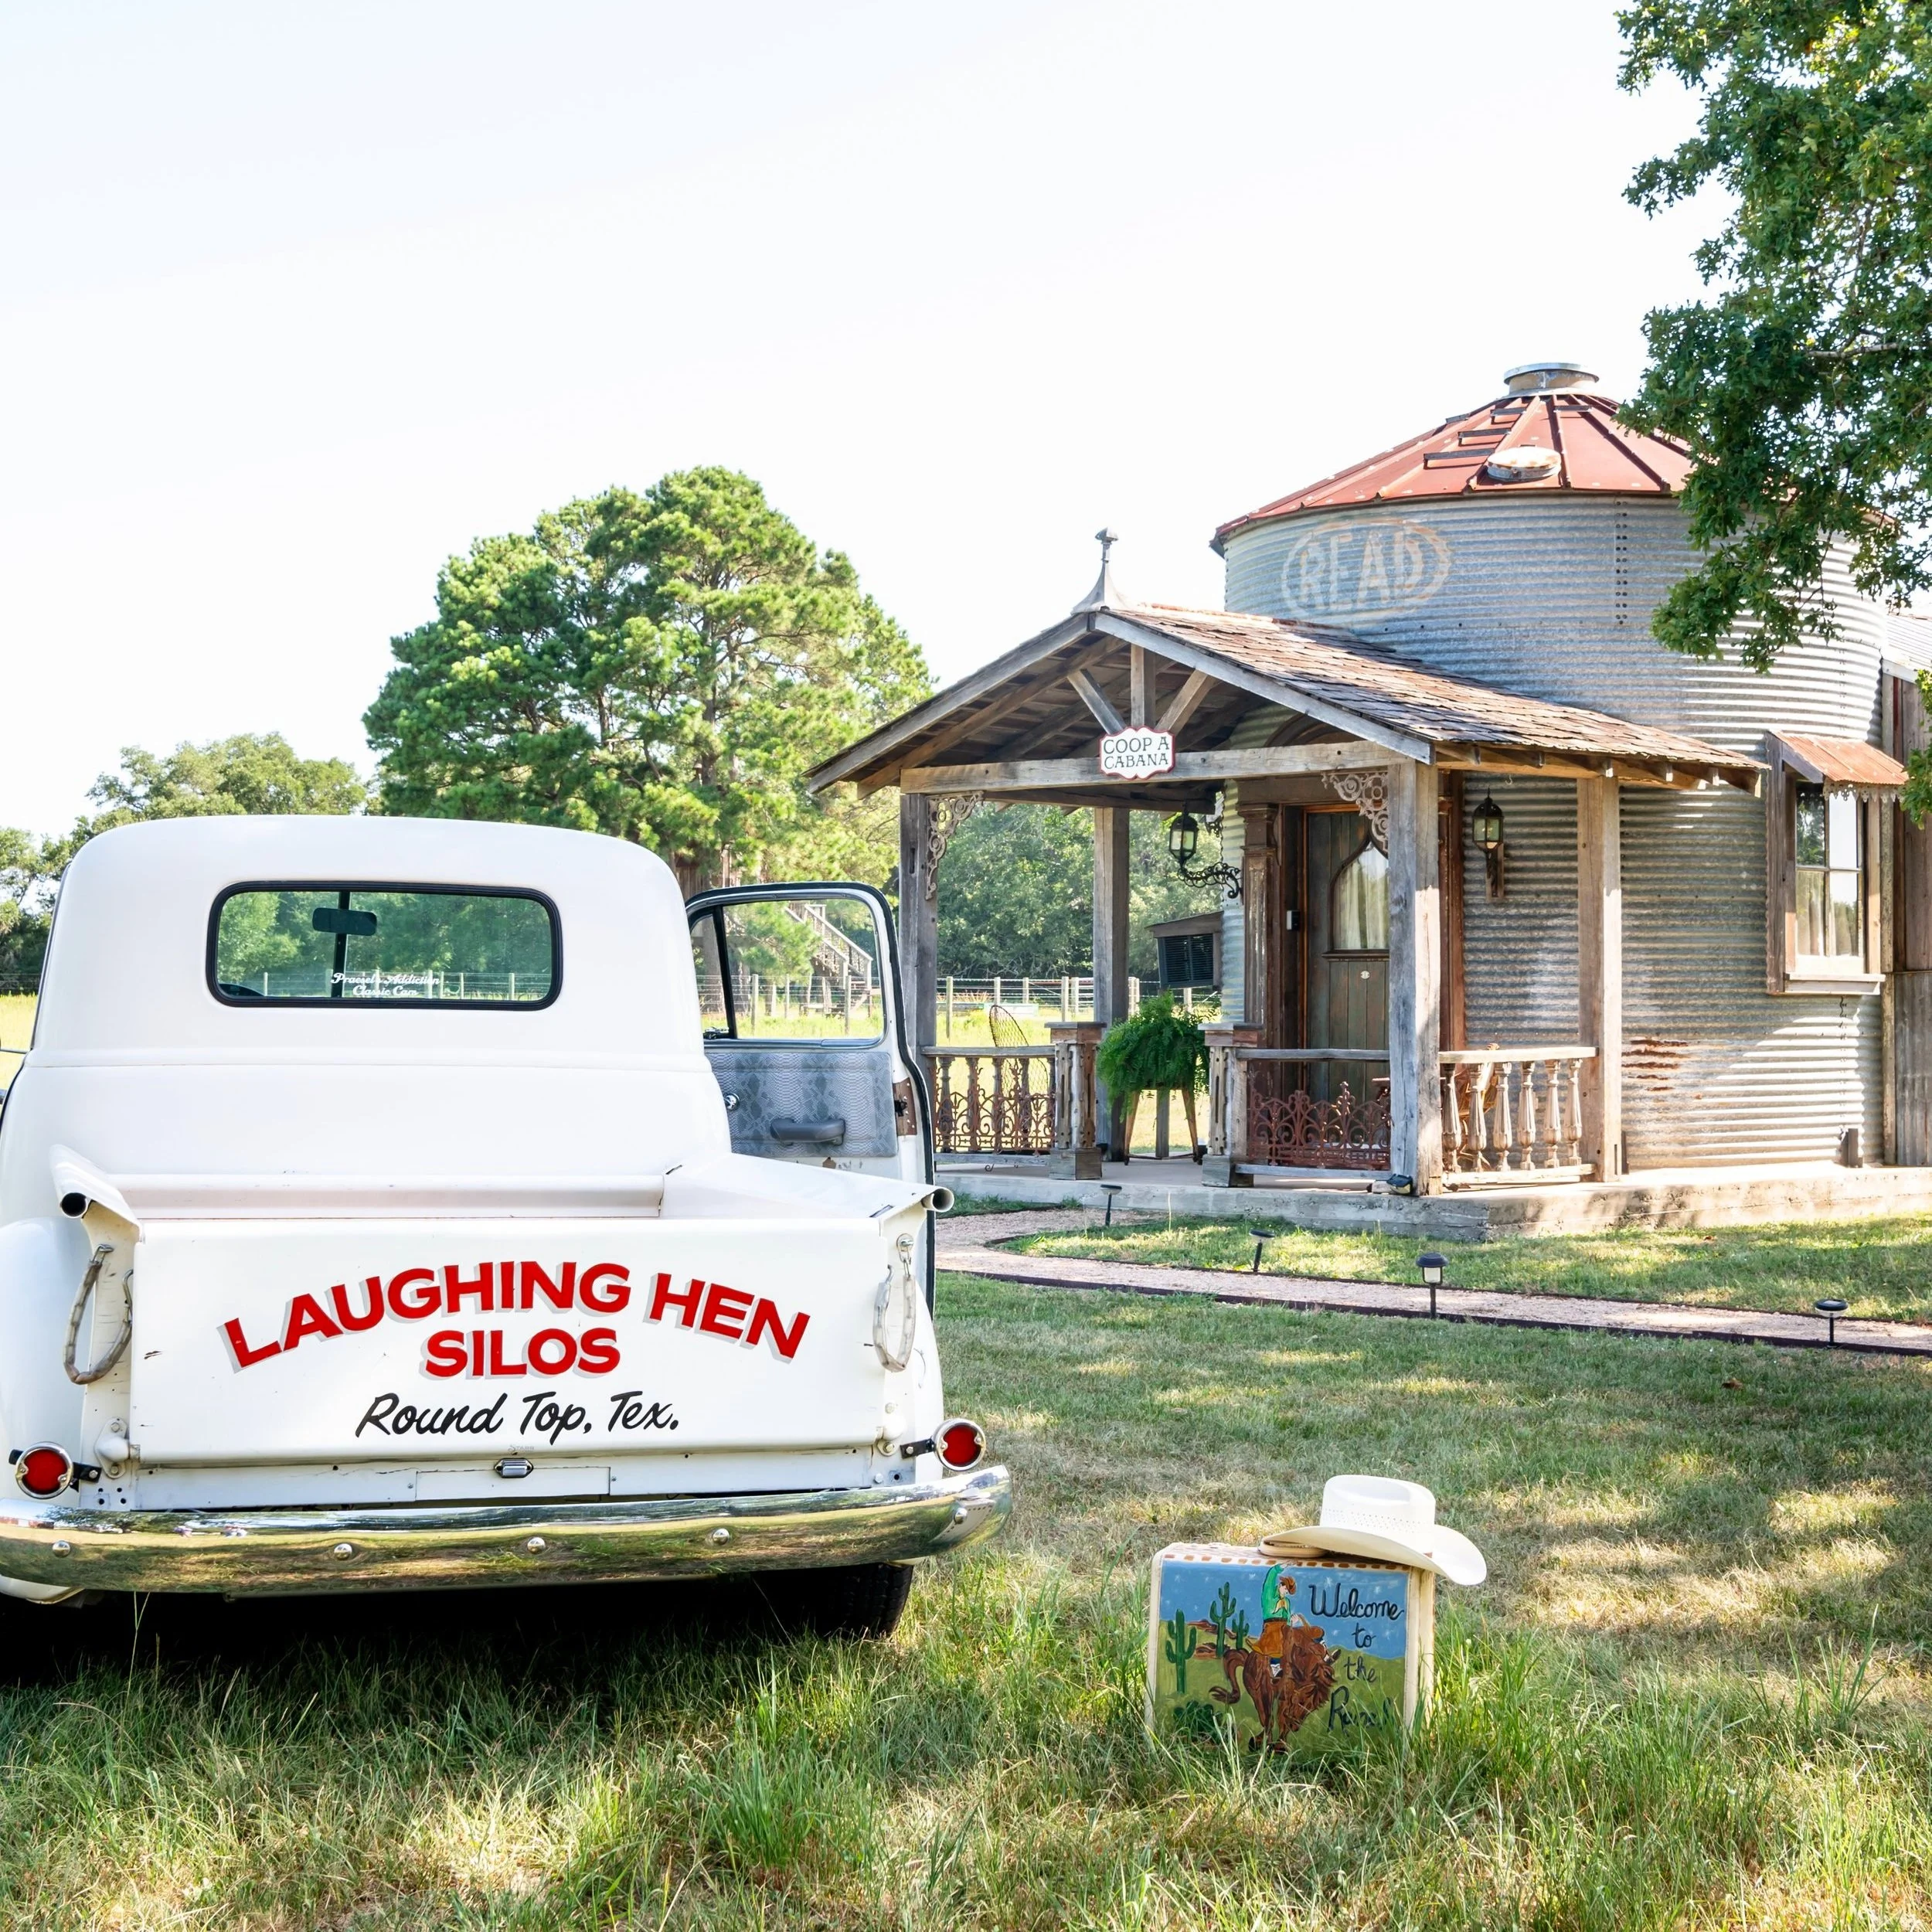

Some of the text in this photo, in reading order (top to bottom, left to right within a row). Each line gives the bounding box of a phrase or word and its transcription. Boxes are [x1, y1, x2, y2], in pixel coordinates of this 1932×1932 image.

[1299, 530, 1424, 608] READ
[1104, 736, 1169, 754] COOP A
[1104, 753, 1168, 770] CABANA
[352, 985, 391, 997] Classic
[218, 1261, 809, 1372] LAUGHING HEN
[420, 1328, 621, 1379] SILOS
[355, 1391, 679, 1445] Round Top, Tex.
[1308, 1583, 1404, 1620] Welcome
[1352, 1622, 1376, 1648] to
[1344, 1656, 1377, 1682] the
